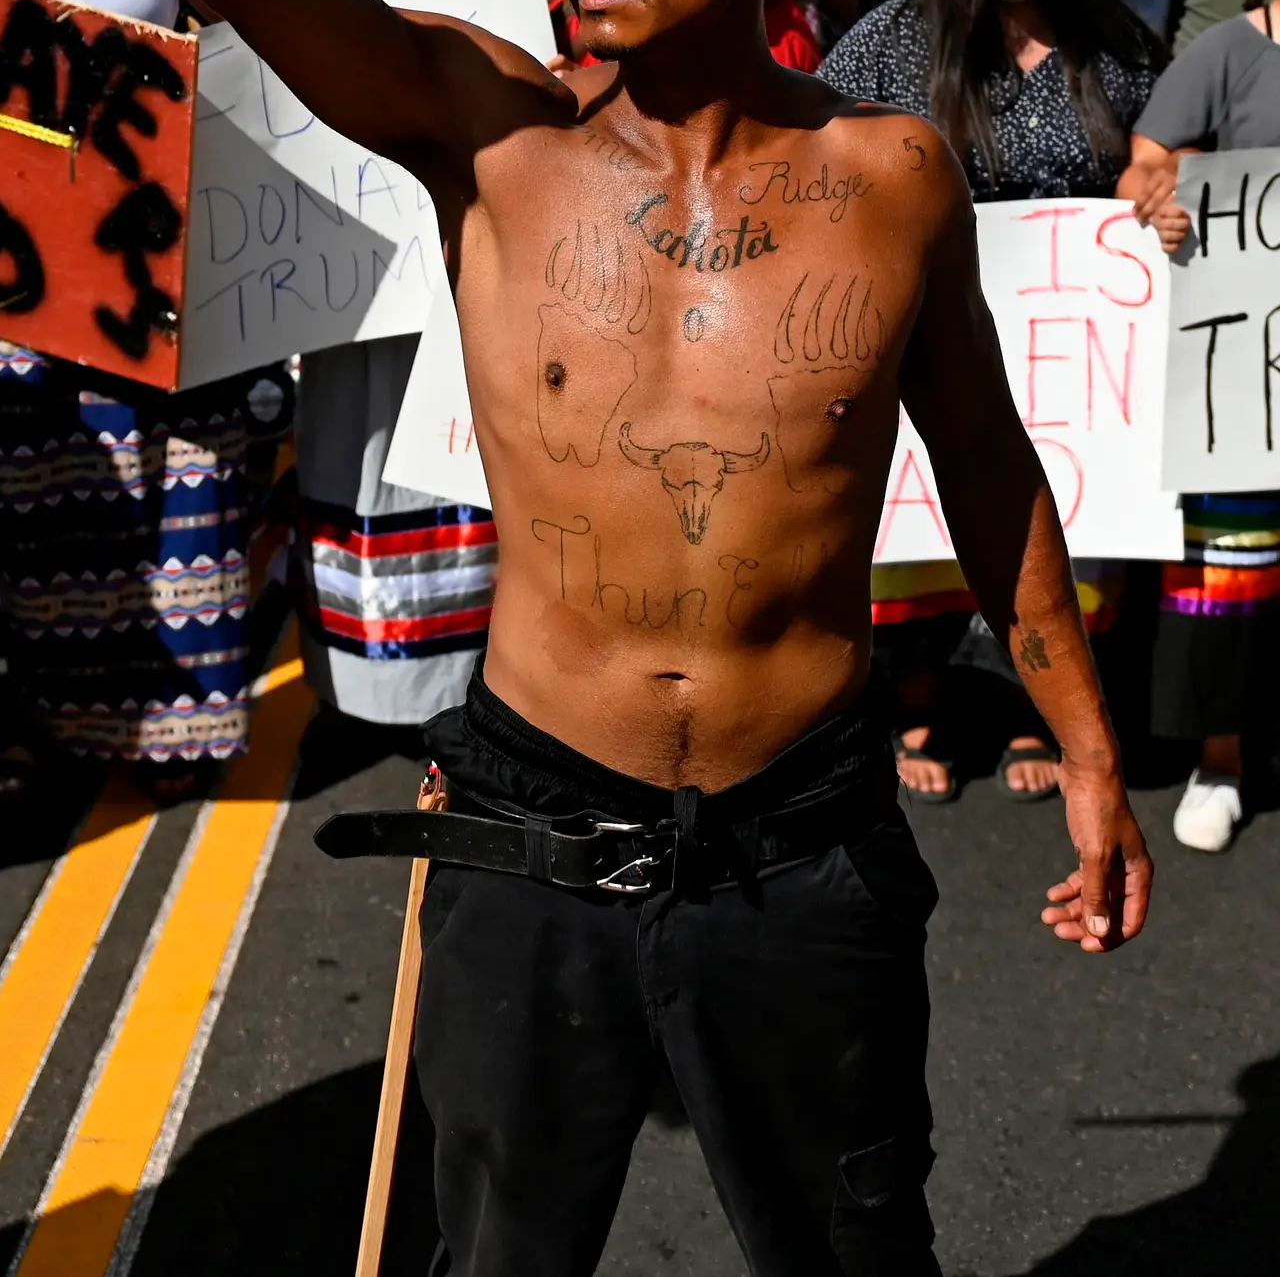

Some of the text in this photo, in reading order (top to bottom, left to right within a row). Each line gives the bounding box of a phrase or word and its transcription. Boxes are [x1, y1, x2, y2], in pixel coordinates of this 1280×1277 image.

[198, 157, 433, 265] DONAL
[625, 189, 780, 273] Lakota
[1010, 207, 1153, 307] IS
[195, 234, 436, 342] TRUM
[1020, 315, 1136, 430] EN
